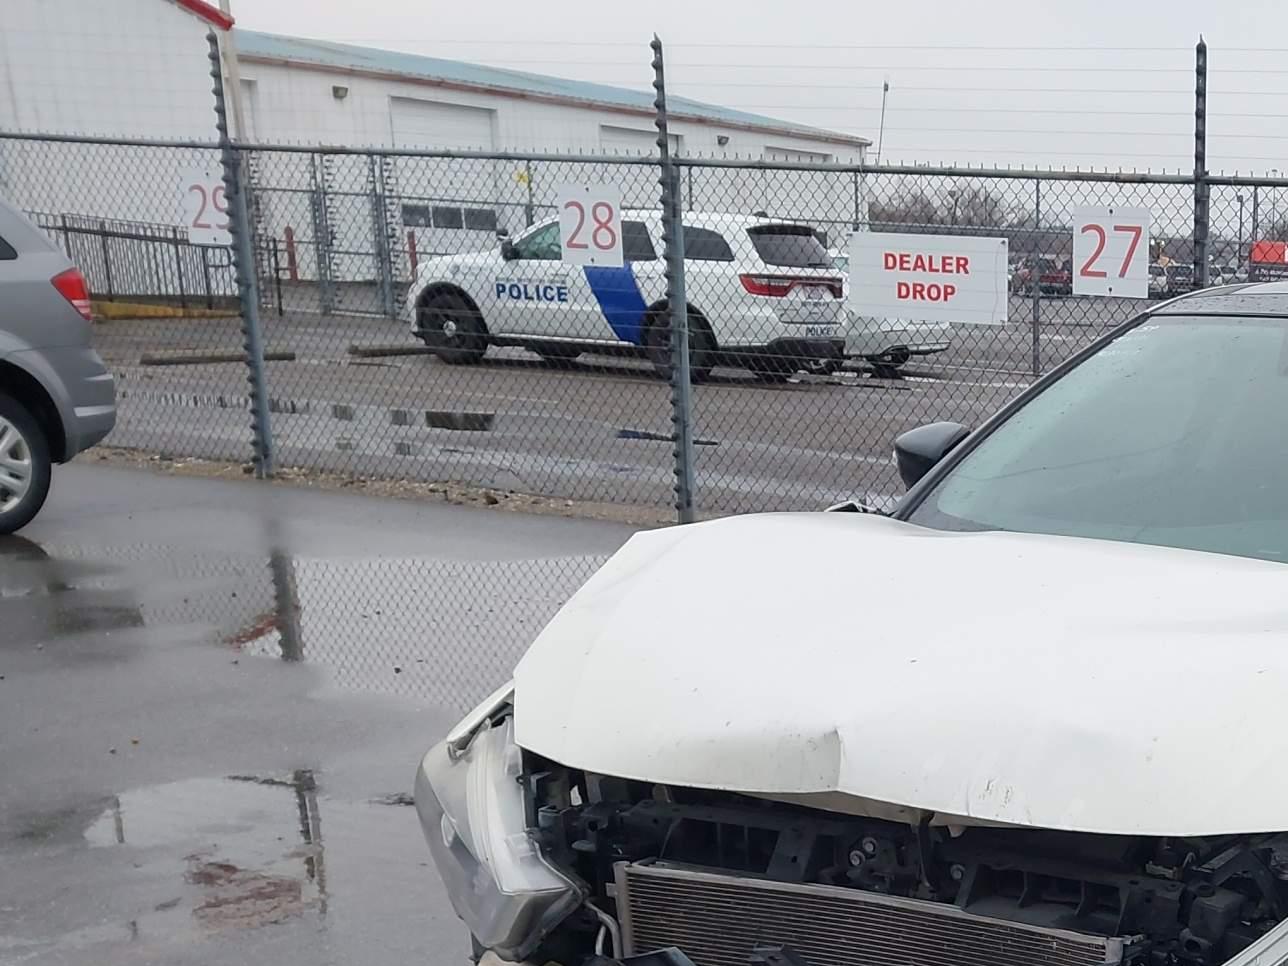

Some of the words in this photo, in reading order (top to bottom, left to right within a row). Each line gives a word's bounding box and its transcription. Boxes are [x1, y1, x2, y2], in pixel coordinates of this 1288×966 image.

[564, 200, 617, 251] 28
[1080, 223, 1142, 279] 27
[883, 252, 970, 275] DEALER
[495, 282, 569, 303] POLICE
[897, 281, 956, 302] DROP
